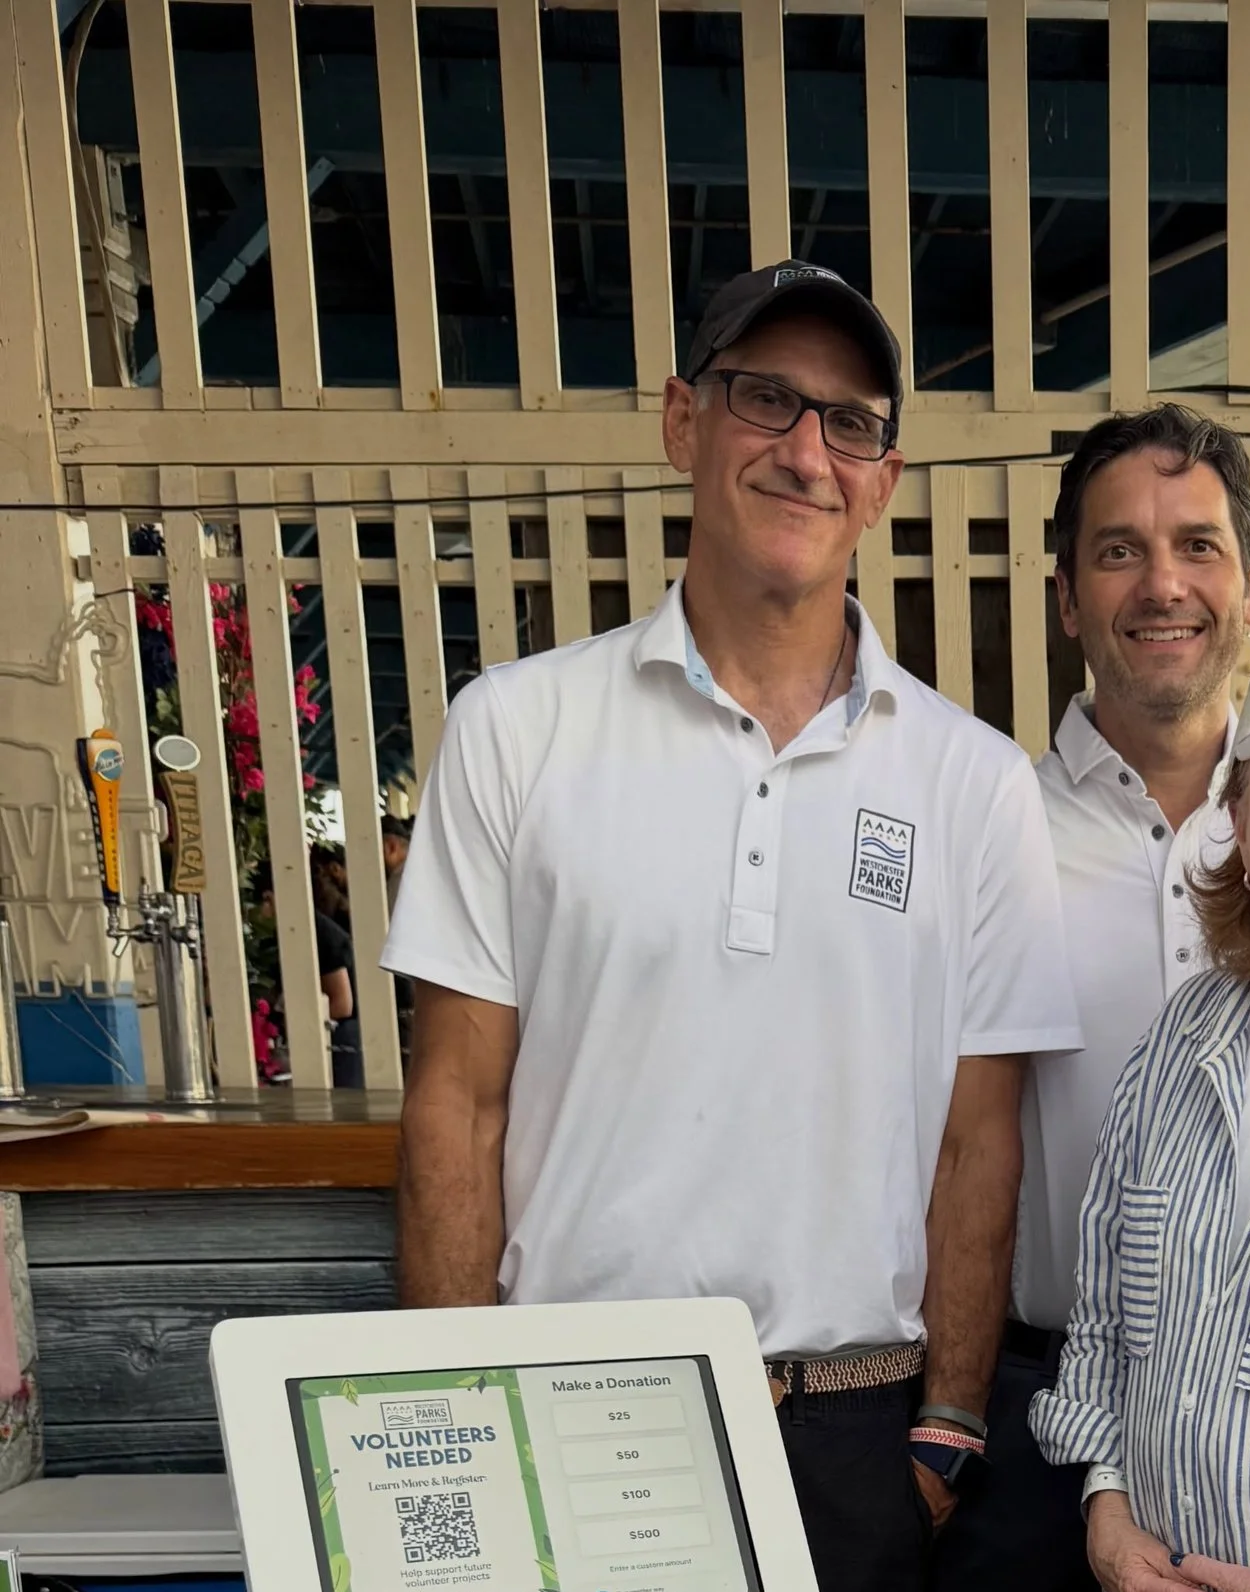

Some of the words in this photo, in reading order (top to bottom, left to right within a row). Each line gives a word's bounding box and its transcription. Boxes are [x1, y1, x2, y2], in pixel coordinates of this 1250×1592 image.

[168, 776, 205, 889] ITHACA
[860, 858, 905, 877] WESTCHESTER
[858, 868, 903, 894] PARKS
[856, 884, 901, 904] FOUNDATION
[552, 1378, 592, 1392] Make
[594, 1381, 604, 1390] a
[606, 1374, 672, 1390] Donation
[416, 1408, 447, 1419] PARKS
[608, 1410, 631, 1422] $25
[351, 1426, 496, 1451] VOLUNTEERS
[385, 1448, 472, 1469] NEEDED
[616, 1450, 640, 1461] $50
[368, 1480, 398, 1492] Learn
[402, 1478, 428, 1490] More
[431, 1477, 440, 1487] &
[442, 1473, 488, 1488] Register:
[622, 1488, 651, 1500] $100
[629, 1529, 660, 1540] $500
[401, 1569, 423, 1578] Help
[425, 1565, 462, 1577] support
[464, 1563, 491, 1571] future
[665, 1558, 692, 1567] amount
[405, 1576, 450, 1588] volunteer
[452, 1572, 491, 1584] projects
